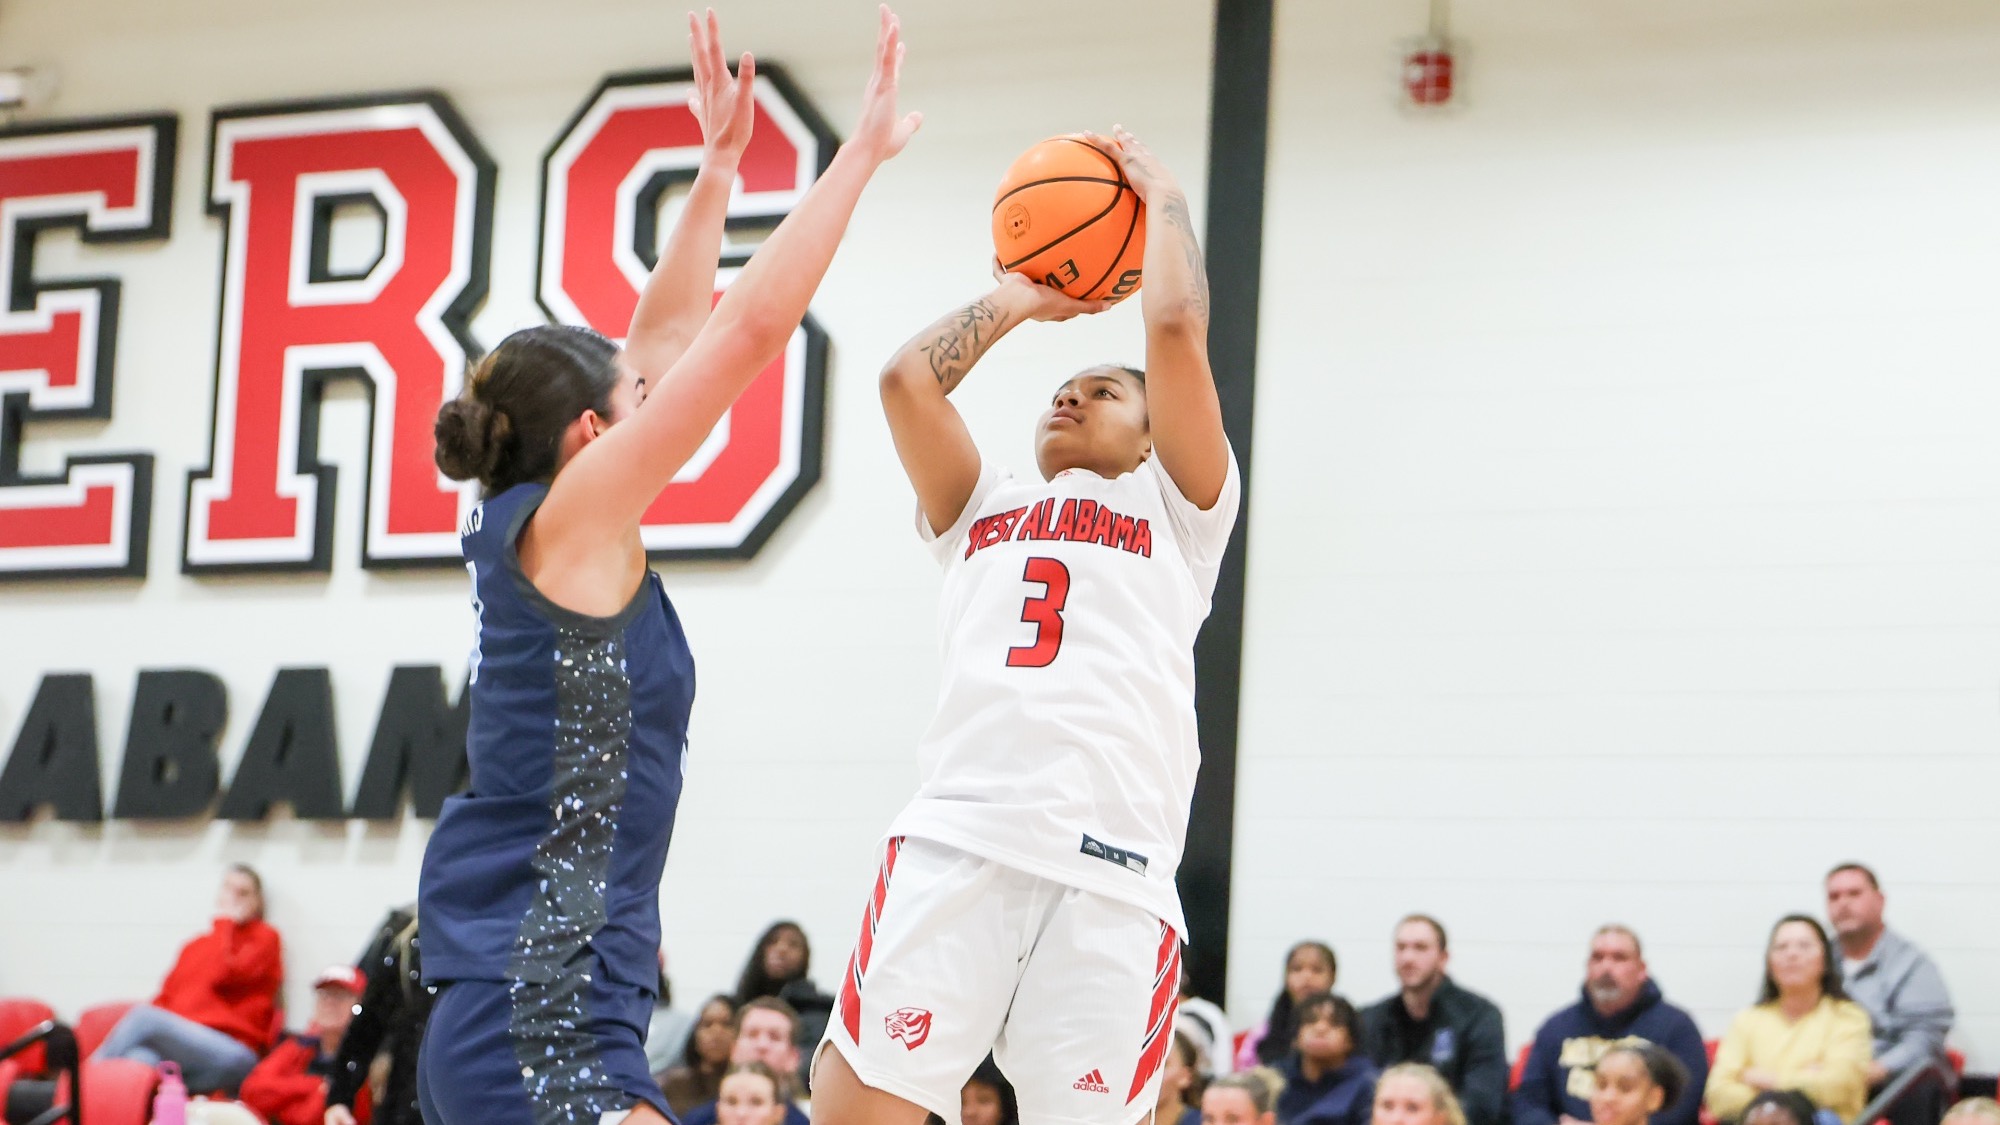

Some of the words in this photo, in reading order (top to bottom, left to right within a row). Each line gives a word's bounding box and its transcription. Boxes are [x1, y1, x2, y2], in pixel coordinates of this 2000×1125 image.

[1034, 258, 1080, 290] EV
[965, 506, 1027, 561] WEST
[1017, 497, 1152, 558] ALABAMA
[1006, 557, 1070, 667] 3
[1072, 1082, 1109, 1094] adidas
